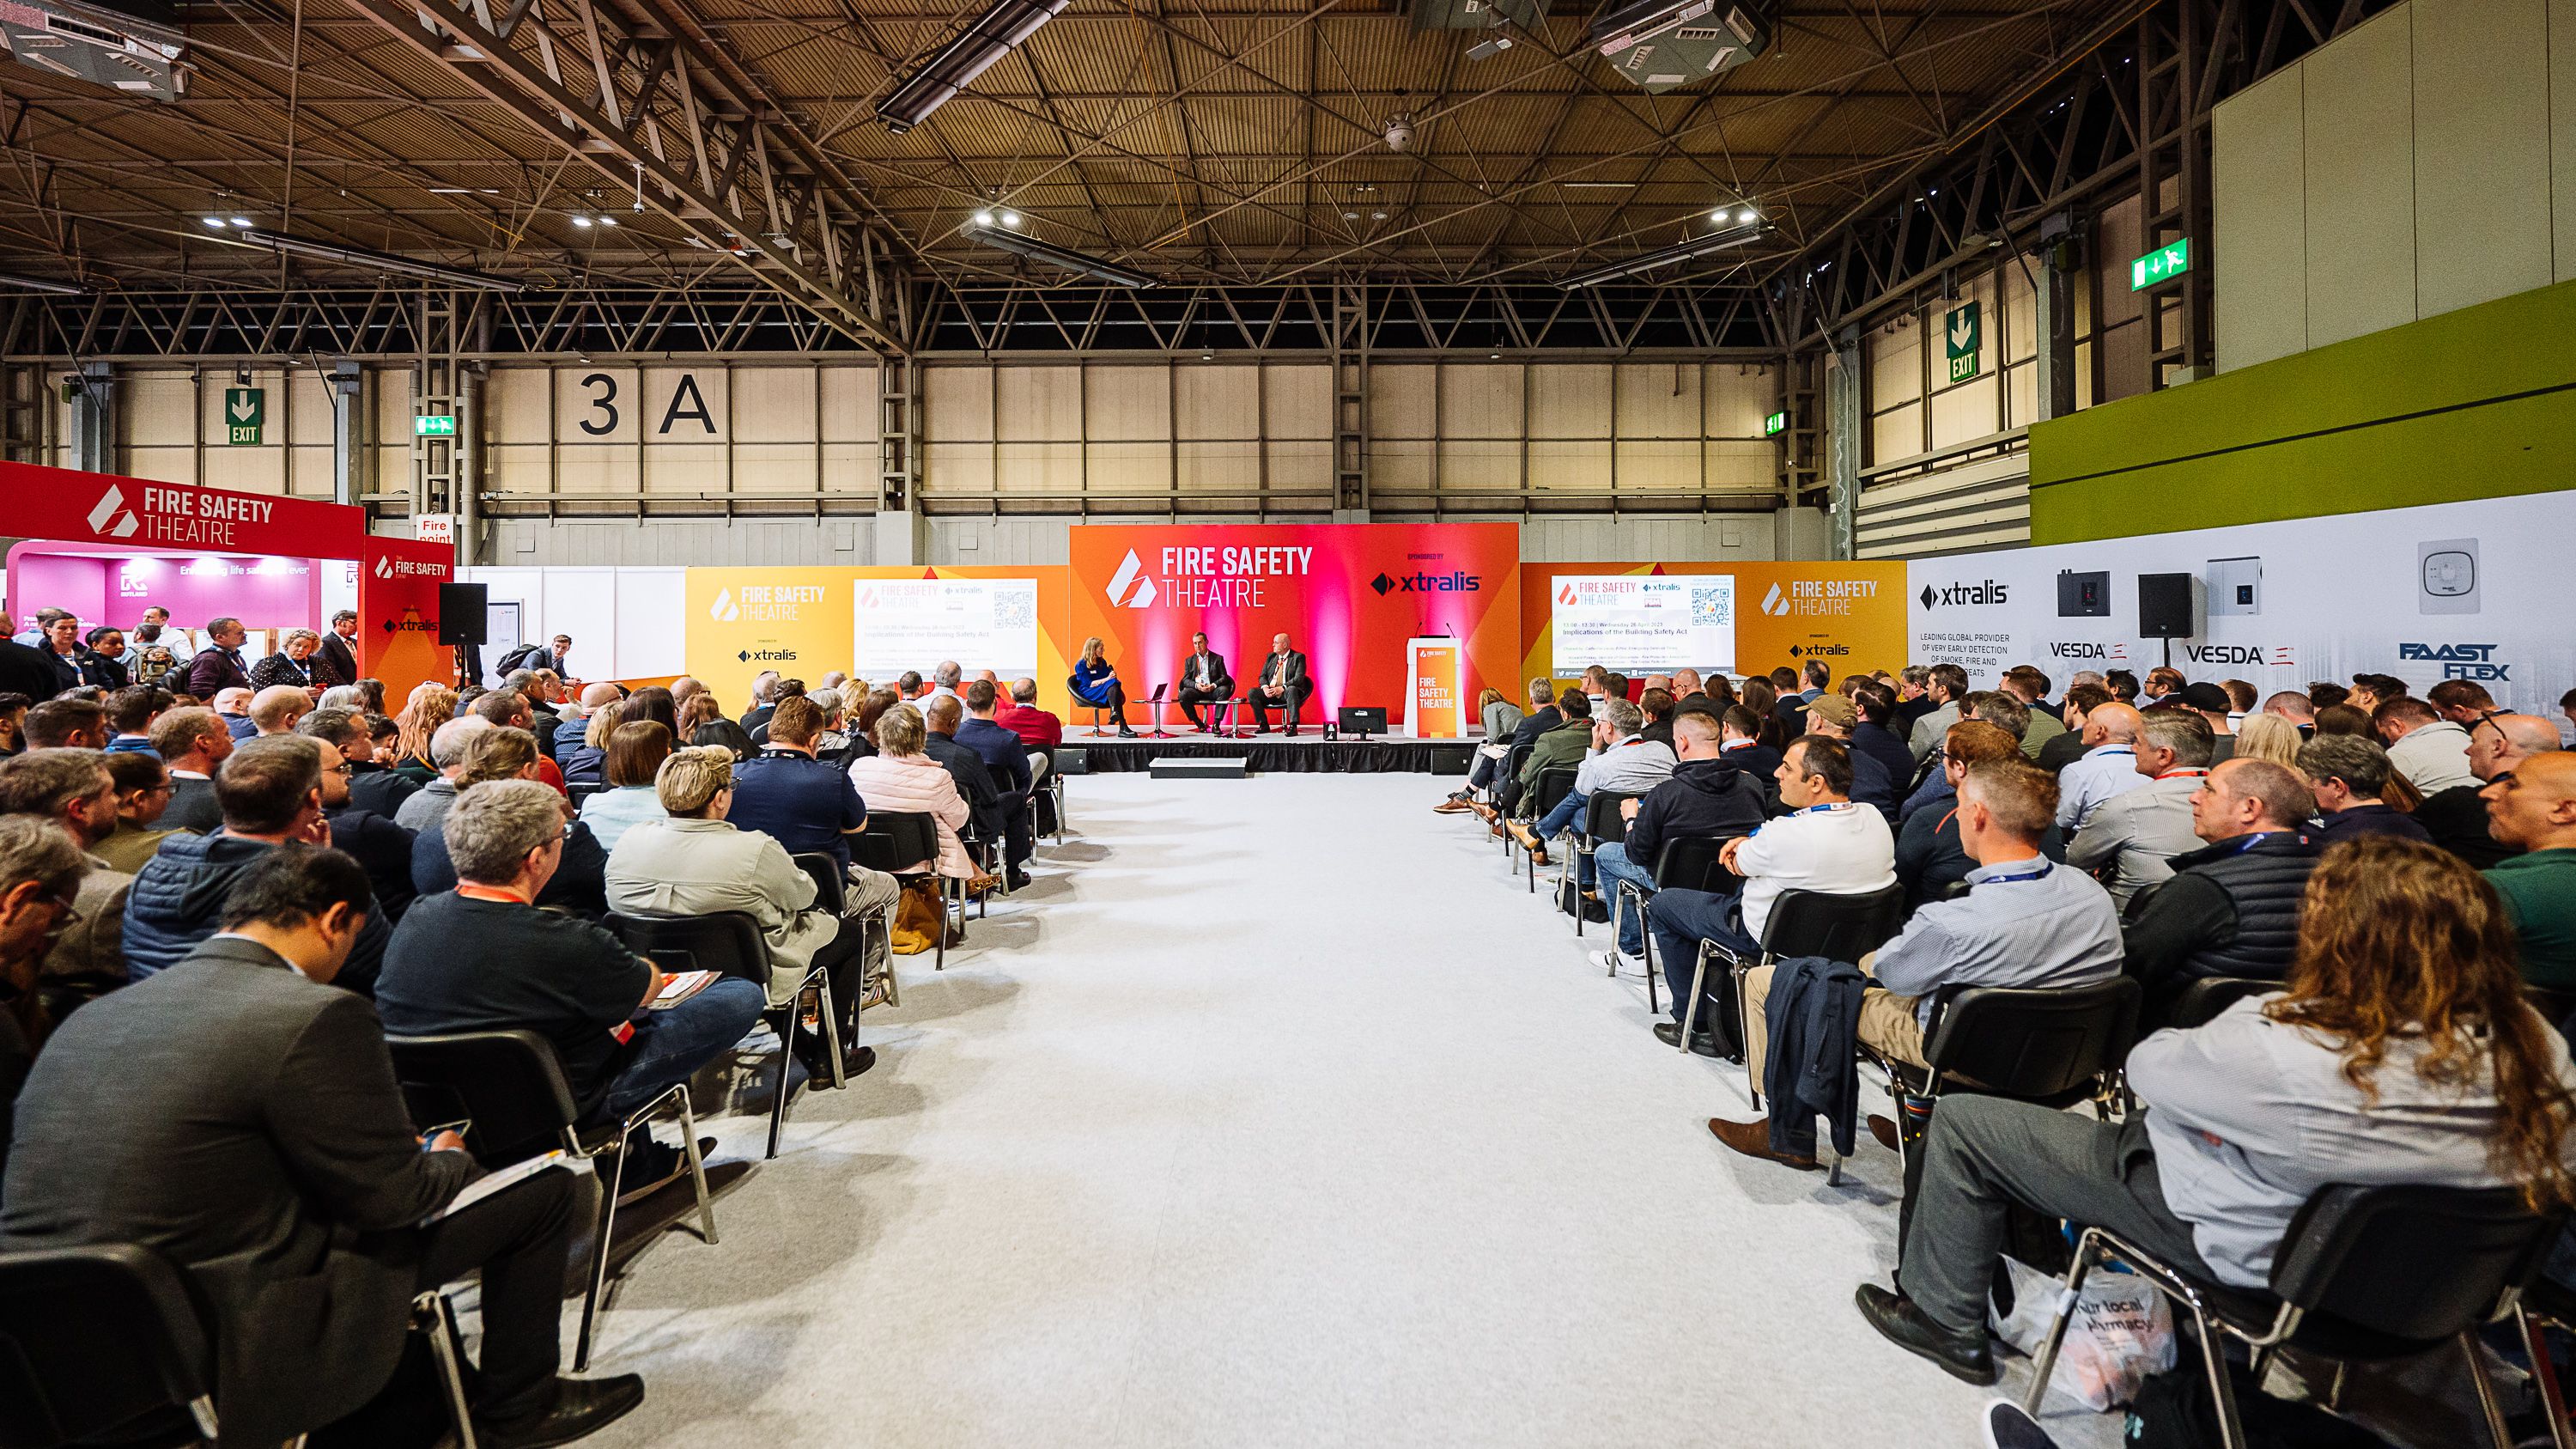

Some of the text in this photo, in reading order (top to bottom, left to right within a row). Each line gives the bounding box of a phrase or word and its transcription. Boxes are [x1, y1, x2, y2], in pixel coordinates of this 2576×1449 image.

[1953, 353, 1973, 378] EXIT
[579, 373, 717, 435] 3 A
[233, 426, 256, 441] EXIT
[144, 487, 273, 524] FIRE SAFETY
[144, 514, 236, 545] THEATRE
[423, 521, 447, 531] Fire
[396, 561, 447, 576] FIRE SAFETY
[1163, 546, 1313, 575] FIRE SAFETY
[1400, 571, 1480, 592] xtralis
[1579, 582, 1637, 593] FIRE SAFETY
[1792, 581, 1878, 597] FIRE SAFETY
[742, 586, 825, 603] FIRE SAFETY
[881, 586, 939, 596] FIRE SAFETY
[955, 586, 983, 594] xtralis
[1161, 579, 1266, 607] THEATRE
[1941, 579, 2008, 606] xtralis
[1579, 594, 1619, 606] THEATRE
[1792, 599, 1851, 616] THEATRE
[742, 605, 799, 621] THEATRE
[398, 618, 438, 631] xtralis
[1975, 634, 2009, 642] PROVIDER
[754, 649, 797, 661] xtralis
[1805, 644, 1850, 655] xtralis
[1947, 644, 1967, 653] EARLY
[1968, 646, 2008, 654] DETECTION
[2050, 642, 2106, 660] VESDA
[2186, 645, 2264, 665] VESDA
[2399, 642, 2498, 662] FAAST
[1931, 654, 1939, 663] OF
[1941, 655, 1965, 665] SMOKE,
[1966, 656, 1981, 665] FIRE
[2444, 663, 2511, 682] FLEX
[1419, 677, 1437, 687] FIRE
[1419, 687, 1449, 697] SAFETY
[1419, 699, 1454, 709] THEATRE
[2102, 1297, 2145, 1313] local
